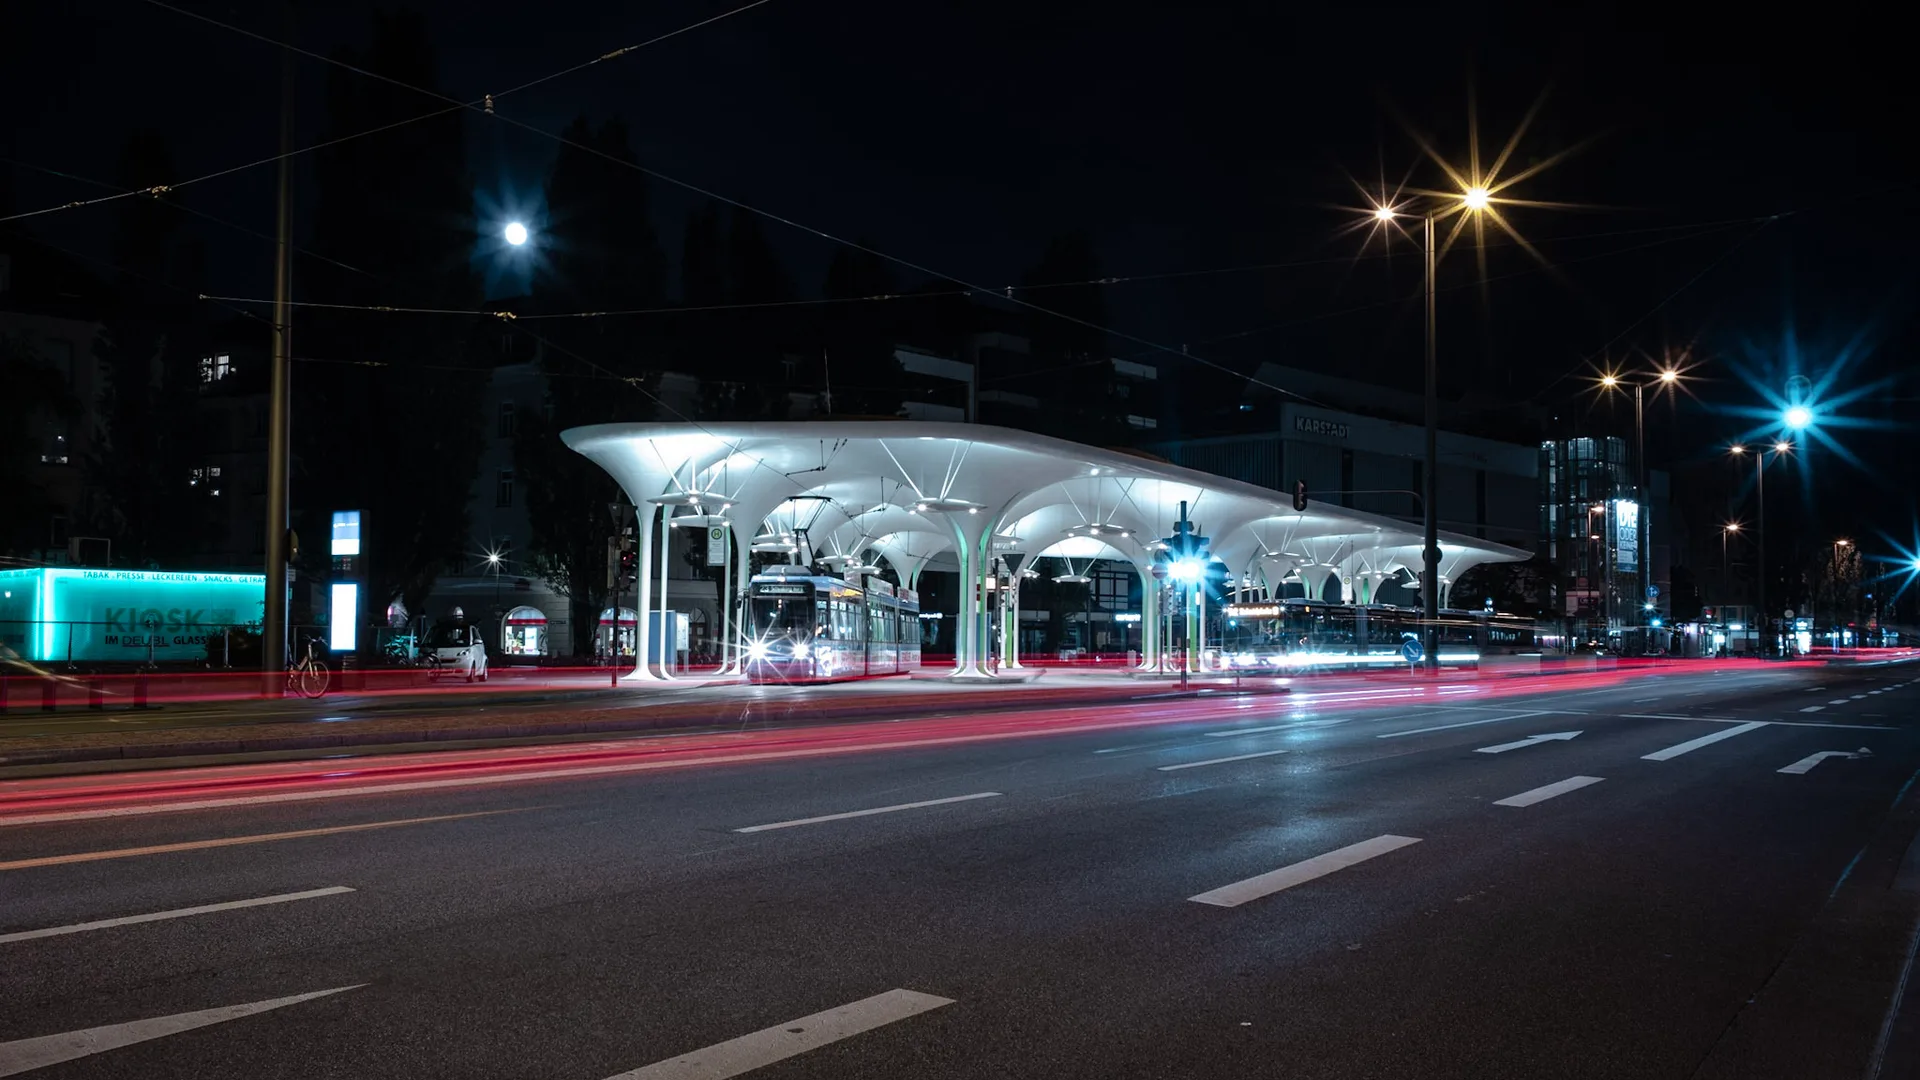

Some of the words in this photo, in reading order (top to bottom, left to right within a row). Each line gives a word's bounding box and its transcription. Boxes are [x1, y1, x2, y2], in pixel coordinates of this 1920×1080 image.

[1296, 416, 1350, 438] KARSTADT
[83, 571, 109, 579] TABAK
[116, 572, 145, 580] PRESSE
[152, 573, 197, 582] LECKEREIEN
[204, 575, 233, 583] SNACKS
[105, 607, 205, 633] KIOSK
[105, 635, 119, 644] IM
